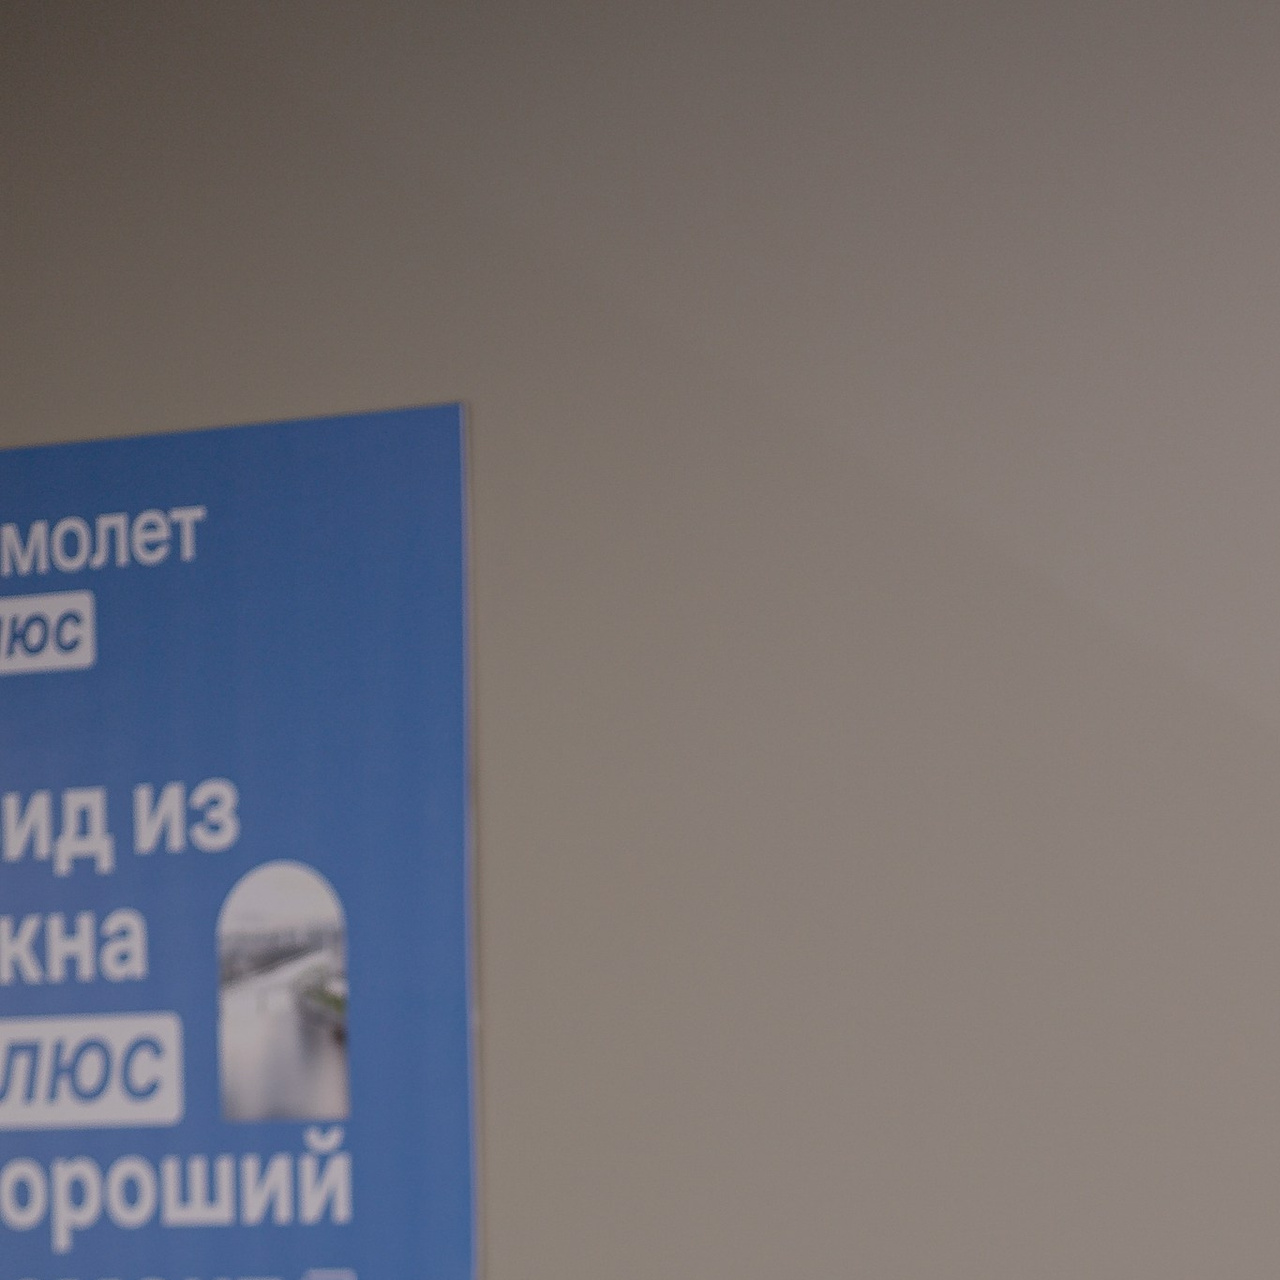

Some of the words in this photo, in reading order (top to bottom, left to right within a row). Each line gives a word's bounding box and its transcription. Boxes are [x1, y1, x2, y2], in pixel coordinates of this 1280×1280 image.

[0, 505, 207, 577] молет
[2, 786, 116, 876] ид
[133, 778, 240, 855] из
[0, 908, 148, 986] кна
[0, 1034, 165, 1104] люс
[0, 1124, 353, 1255] ороший
